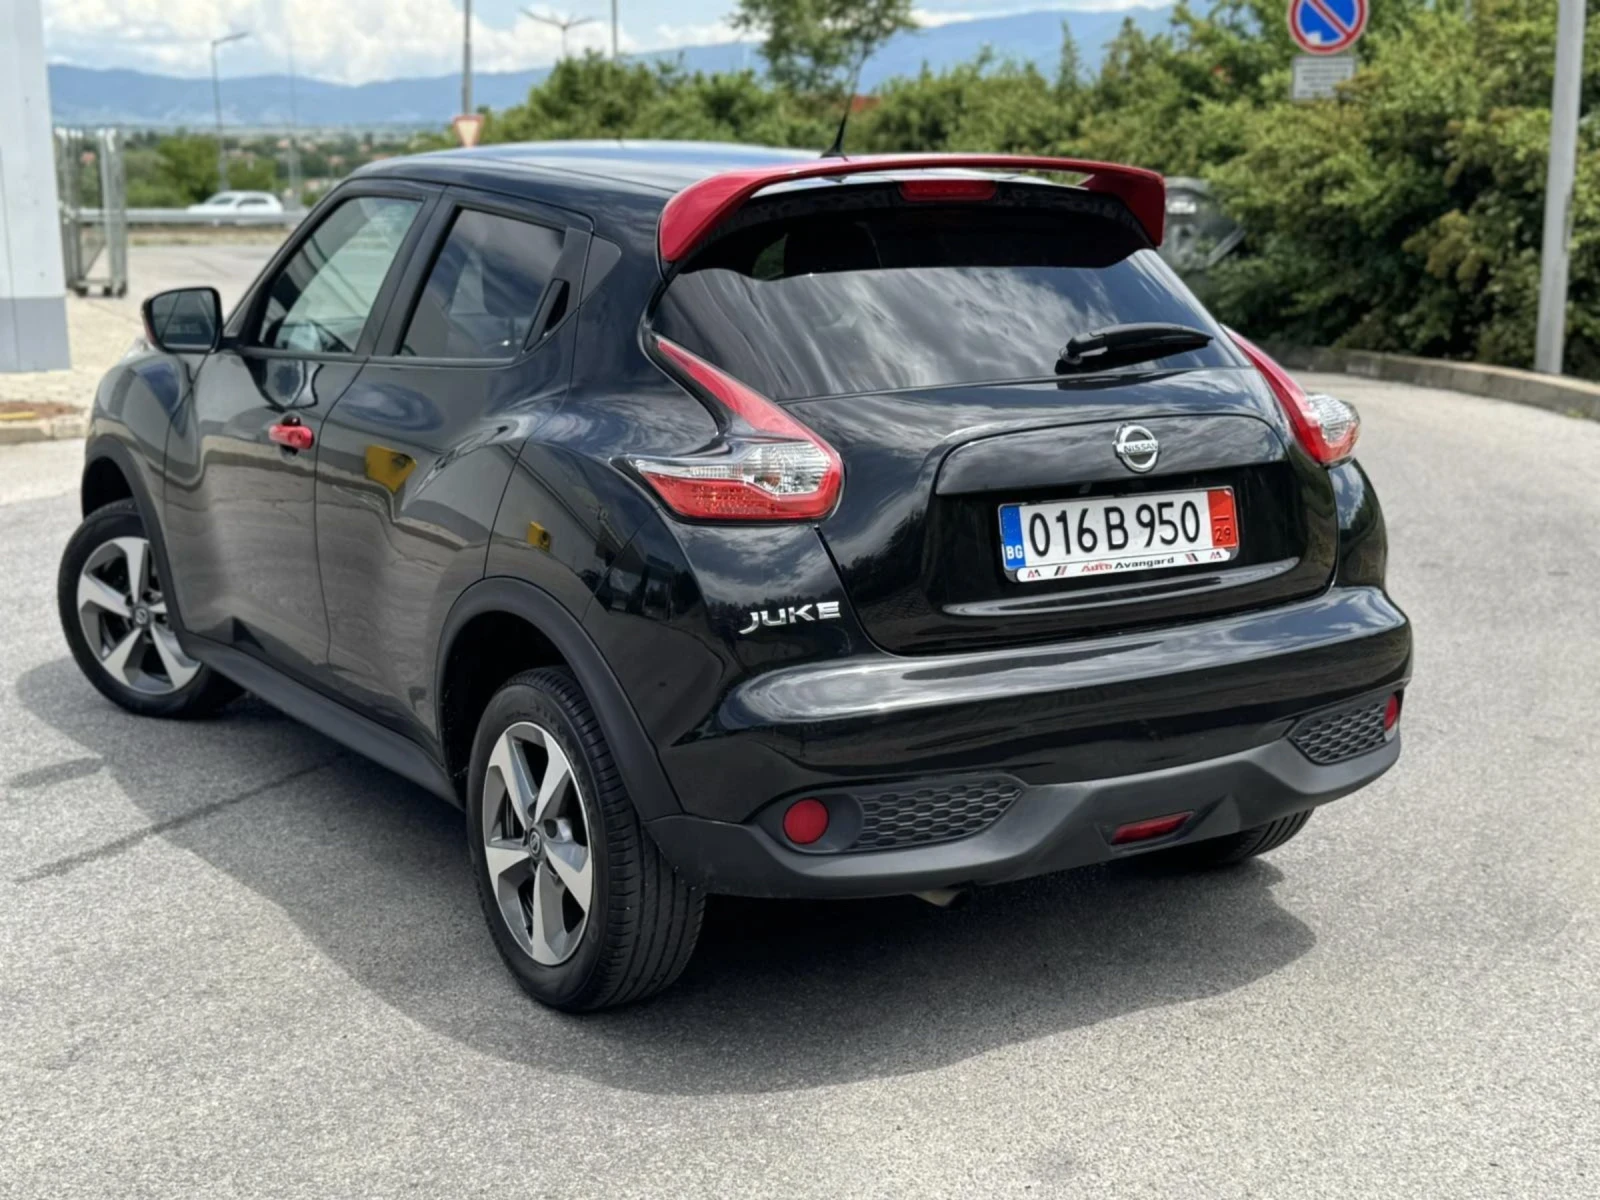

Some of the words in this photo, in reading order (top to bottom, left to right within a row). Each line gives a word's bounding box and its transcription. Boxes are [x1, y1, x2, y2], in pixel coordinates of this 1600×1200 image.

[1124, 442, 1158, 454] NISSAN
[1006, 545, 1023, 560] BG
[1081, 561, 1113, 572] Auto
[1114, 557, 1175, 570] Avangard
[738, 601, 841, 635] JUKE
